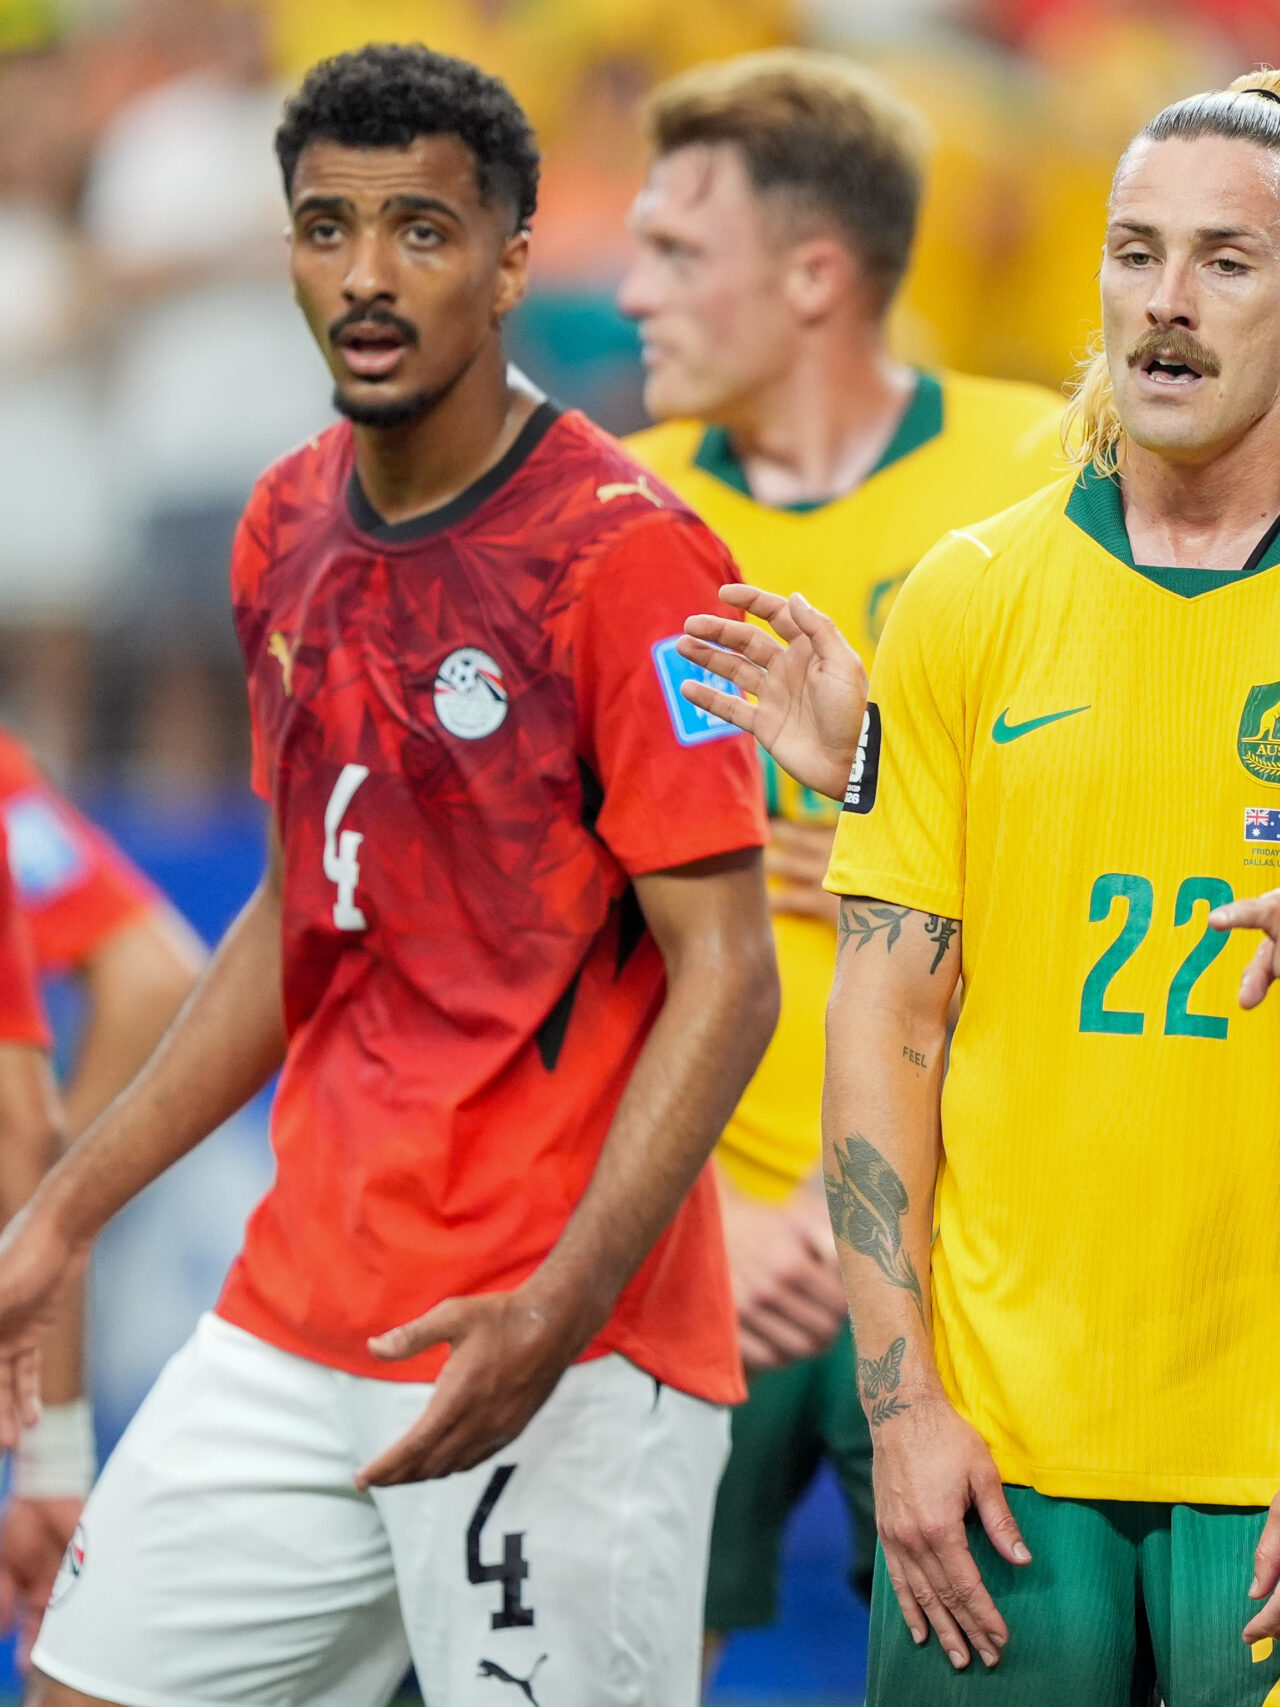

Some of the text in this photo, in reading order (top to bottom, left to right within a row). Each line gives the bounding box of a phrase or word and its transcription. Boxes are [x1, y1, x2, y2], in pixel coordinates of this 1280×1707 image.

[323, 763, 371, 932] 4
[1243, 858, 1276, 868] DALLAS,
[1251, 848, 1280, 857] FRIDAY
[1079, 872, 1234, 1040] 22
[902, 1046, 928, 1069] FEEL
[465, 1463, 535, 1631] 4
